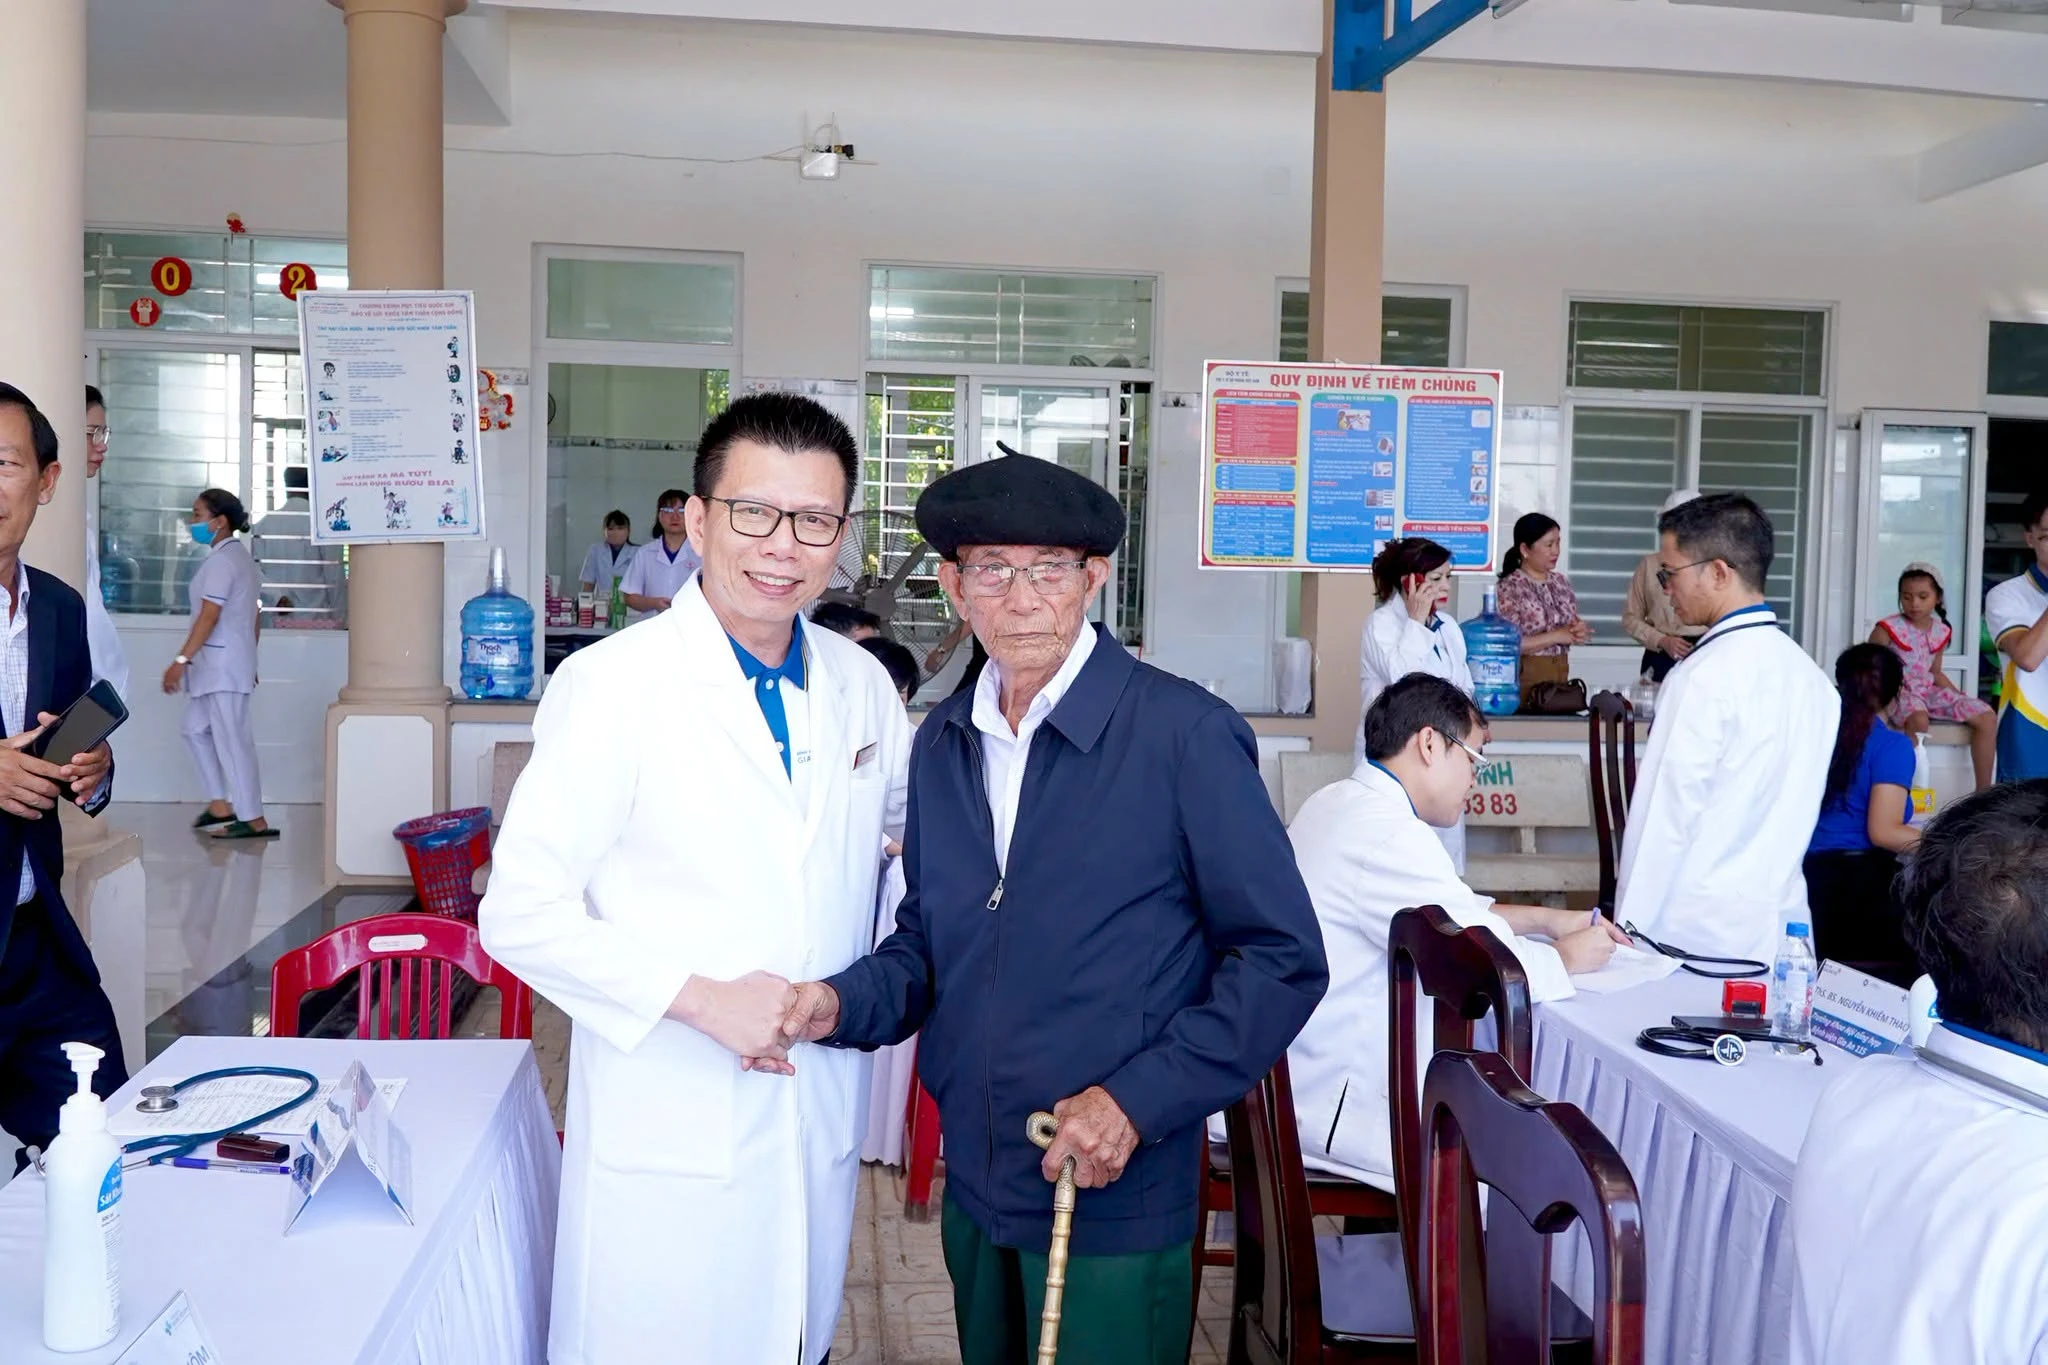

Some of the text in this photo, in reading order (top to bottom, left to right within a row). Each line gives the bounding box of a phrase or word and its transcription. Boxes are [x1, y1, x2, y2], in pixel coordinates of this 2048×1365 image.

[160, 262, 307, 295] 0 2
[1270, 373, 1477, 392] QUY ĐỊNH VỀ TIÊM CHỦNG
[1490, 794, 1517, 815] 83
[1838, 996, 1865, 1015] NGUYỄN
